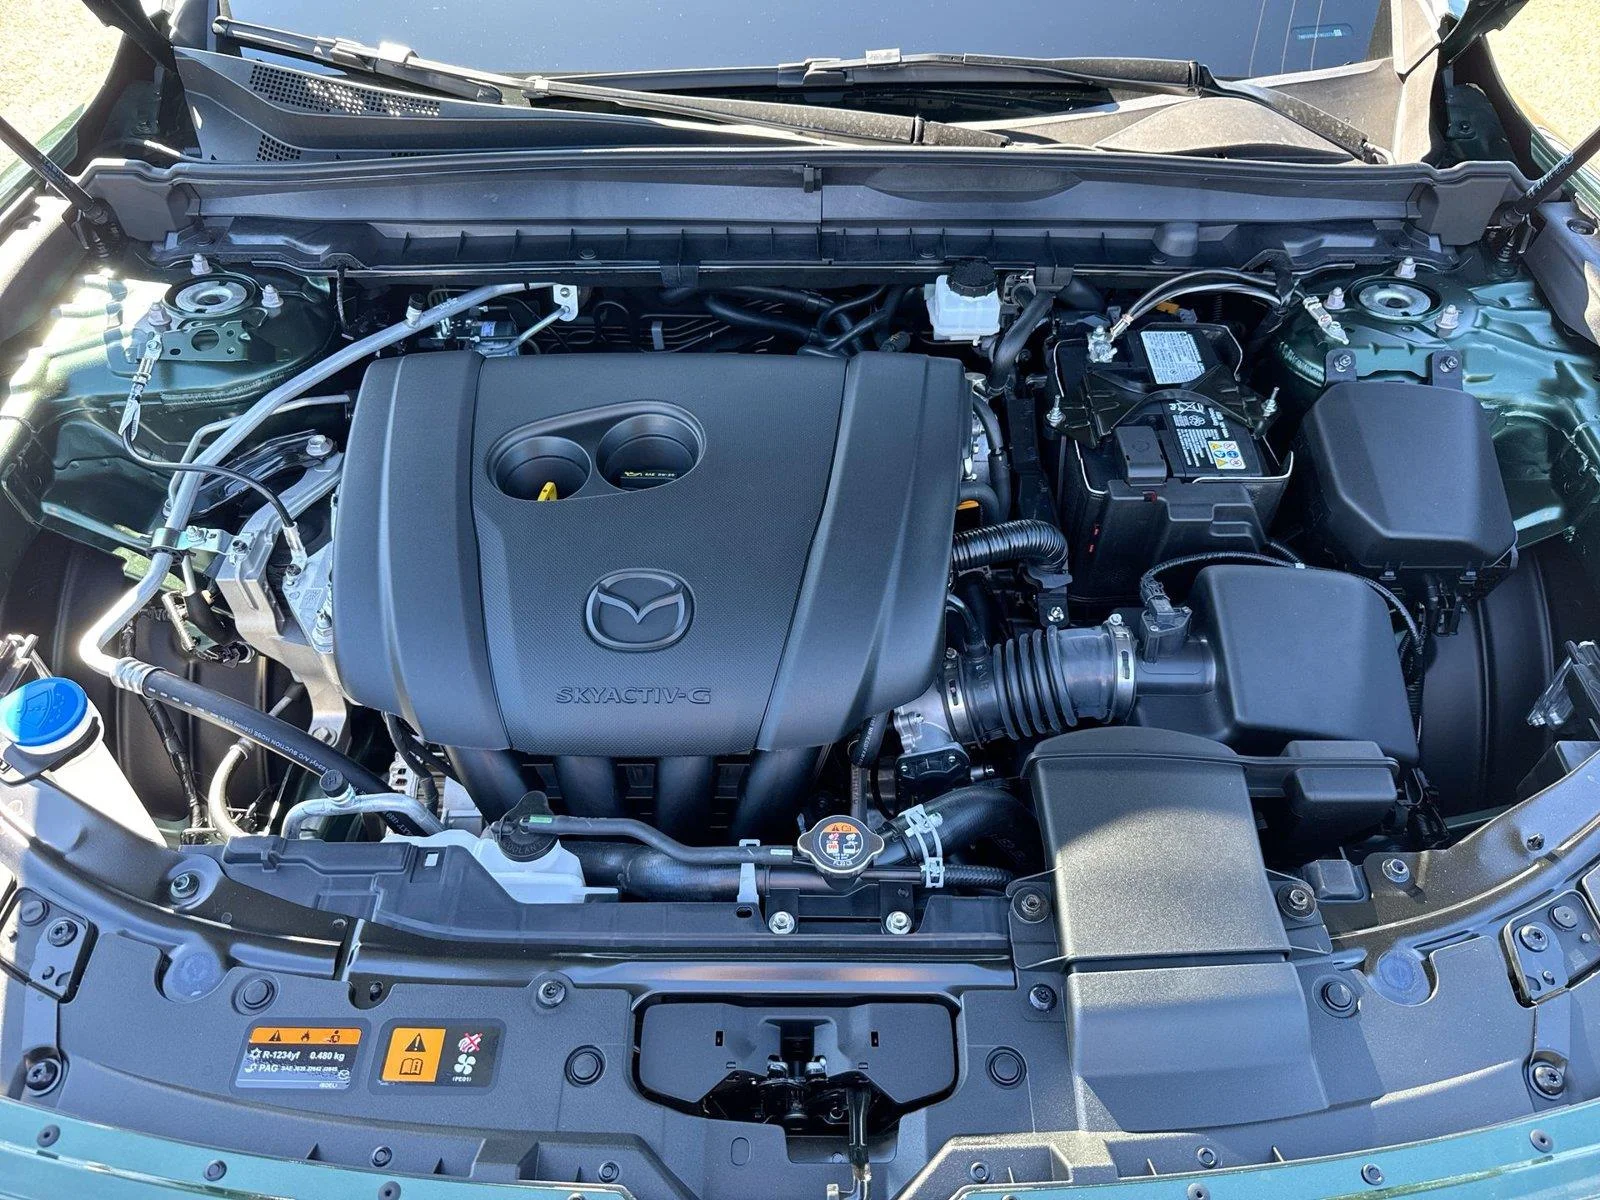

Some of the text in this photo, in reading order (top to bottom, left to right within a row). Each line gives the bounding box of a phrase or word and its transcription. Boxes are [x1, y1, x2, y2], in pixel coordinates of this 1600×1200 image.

[556, 687, 711, 704] SKYACTIV-G
[271, 739, 299, 756] SUCTION
[262, 1051, 345, 1061] R-1234yf 0.480 kg
[258, 1064, 279, 1072] PAG
